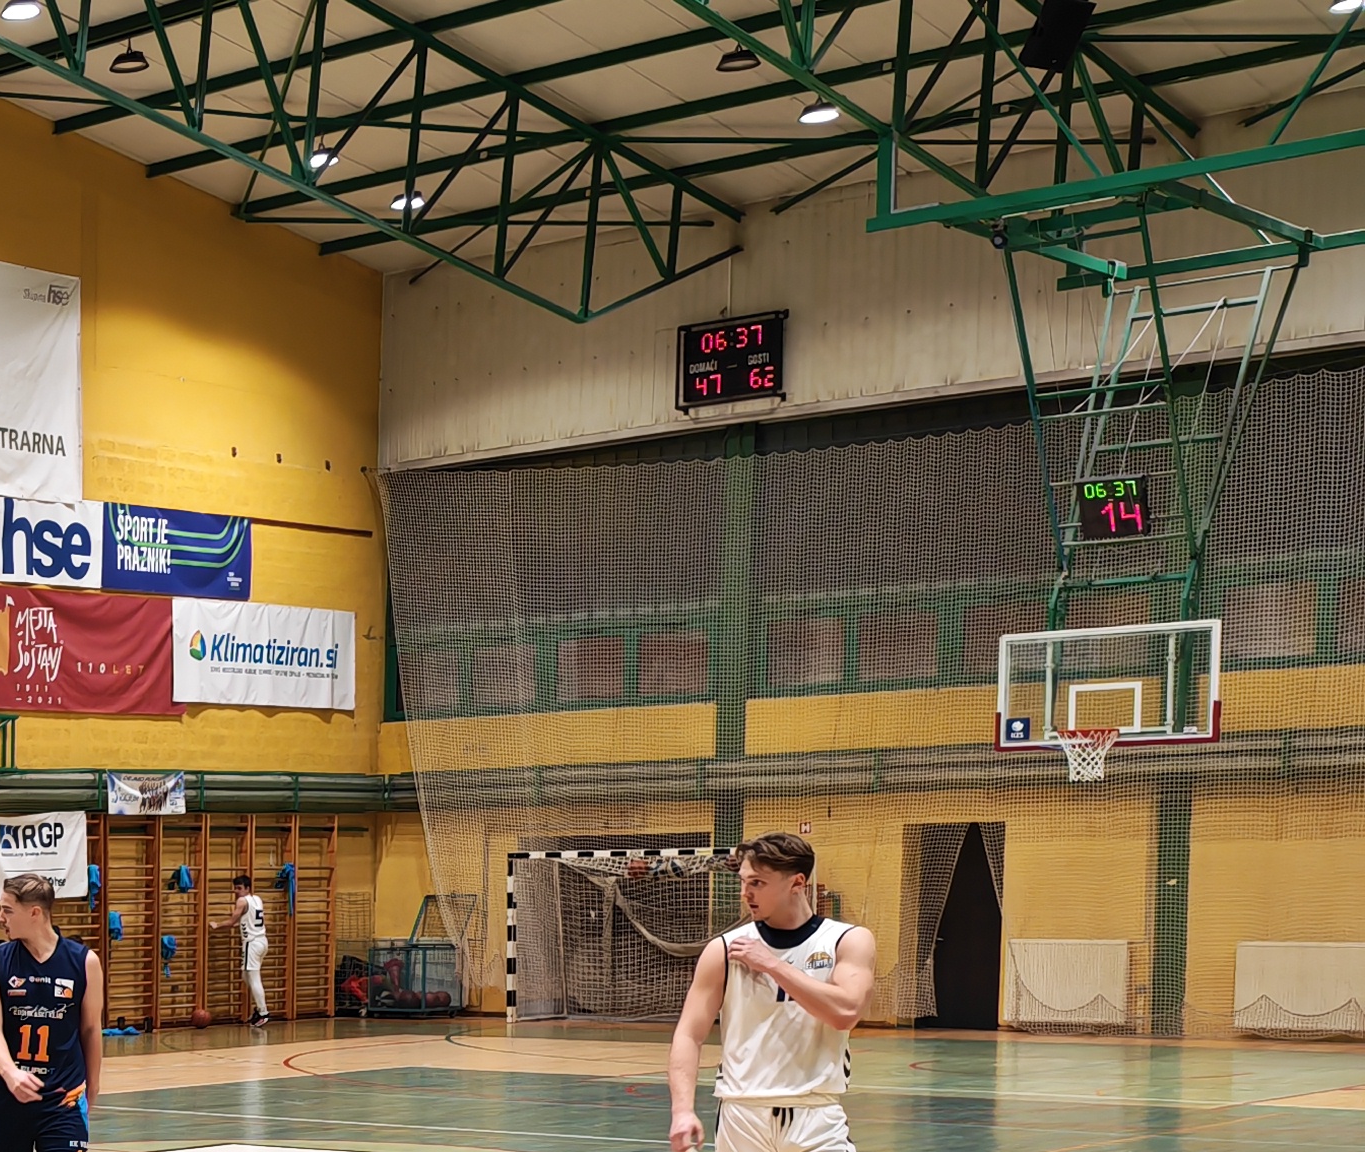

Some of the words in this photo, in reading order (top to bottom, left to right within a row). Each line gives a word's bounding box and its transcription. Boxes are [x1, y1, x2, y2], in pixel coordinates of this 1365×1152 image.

[701, 325, 762, 353] 06:37
[748, 353, 769, 365] GOSTI
[696, 374, 721, 396] 47
[117, 509, 153, 543] ŠPORT
[155, 517, 169, 545] JE
[1101, 501, 1143, 532] 14
[2, 497, 92, 579] hse
[117, 544, 171, 574] PRAZNIK!
[15, 607, 57, 646] MESTA
[210, 633, 339, 669] Klimatiziran.si
[112, 664, 145, 675] LET
[22, 822, 64, 849] RGP
[254, 909, 264, 927] 5
[17, 1024, 50, 1062] 11
